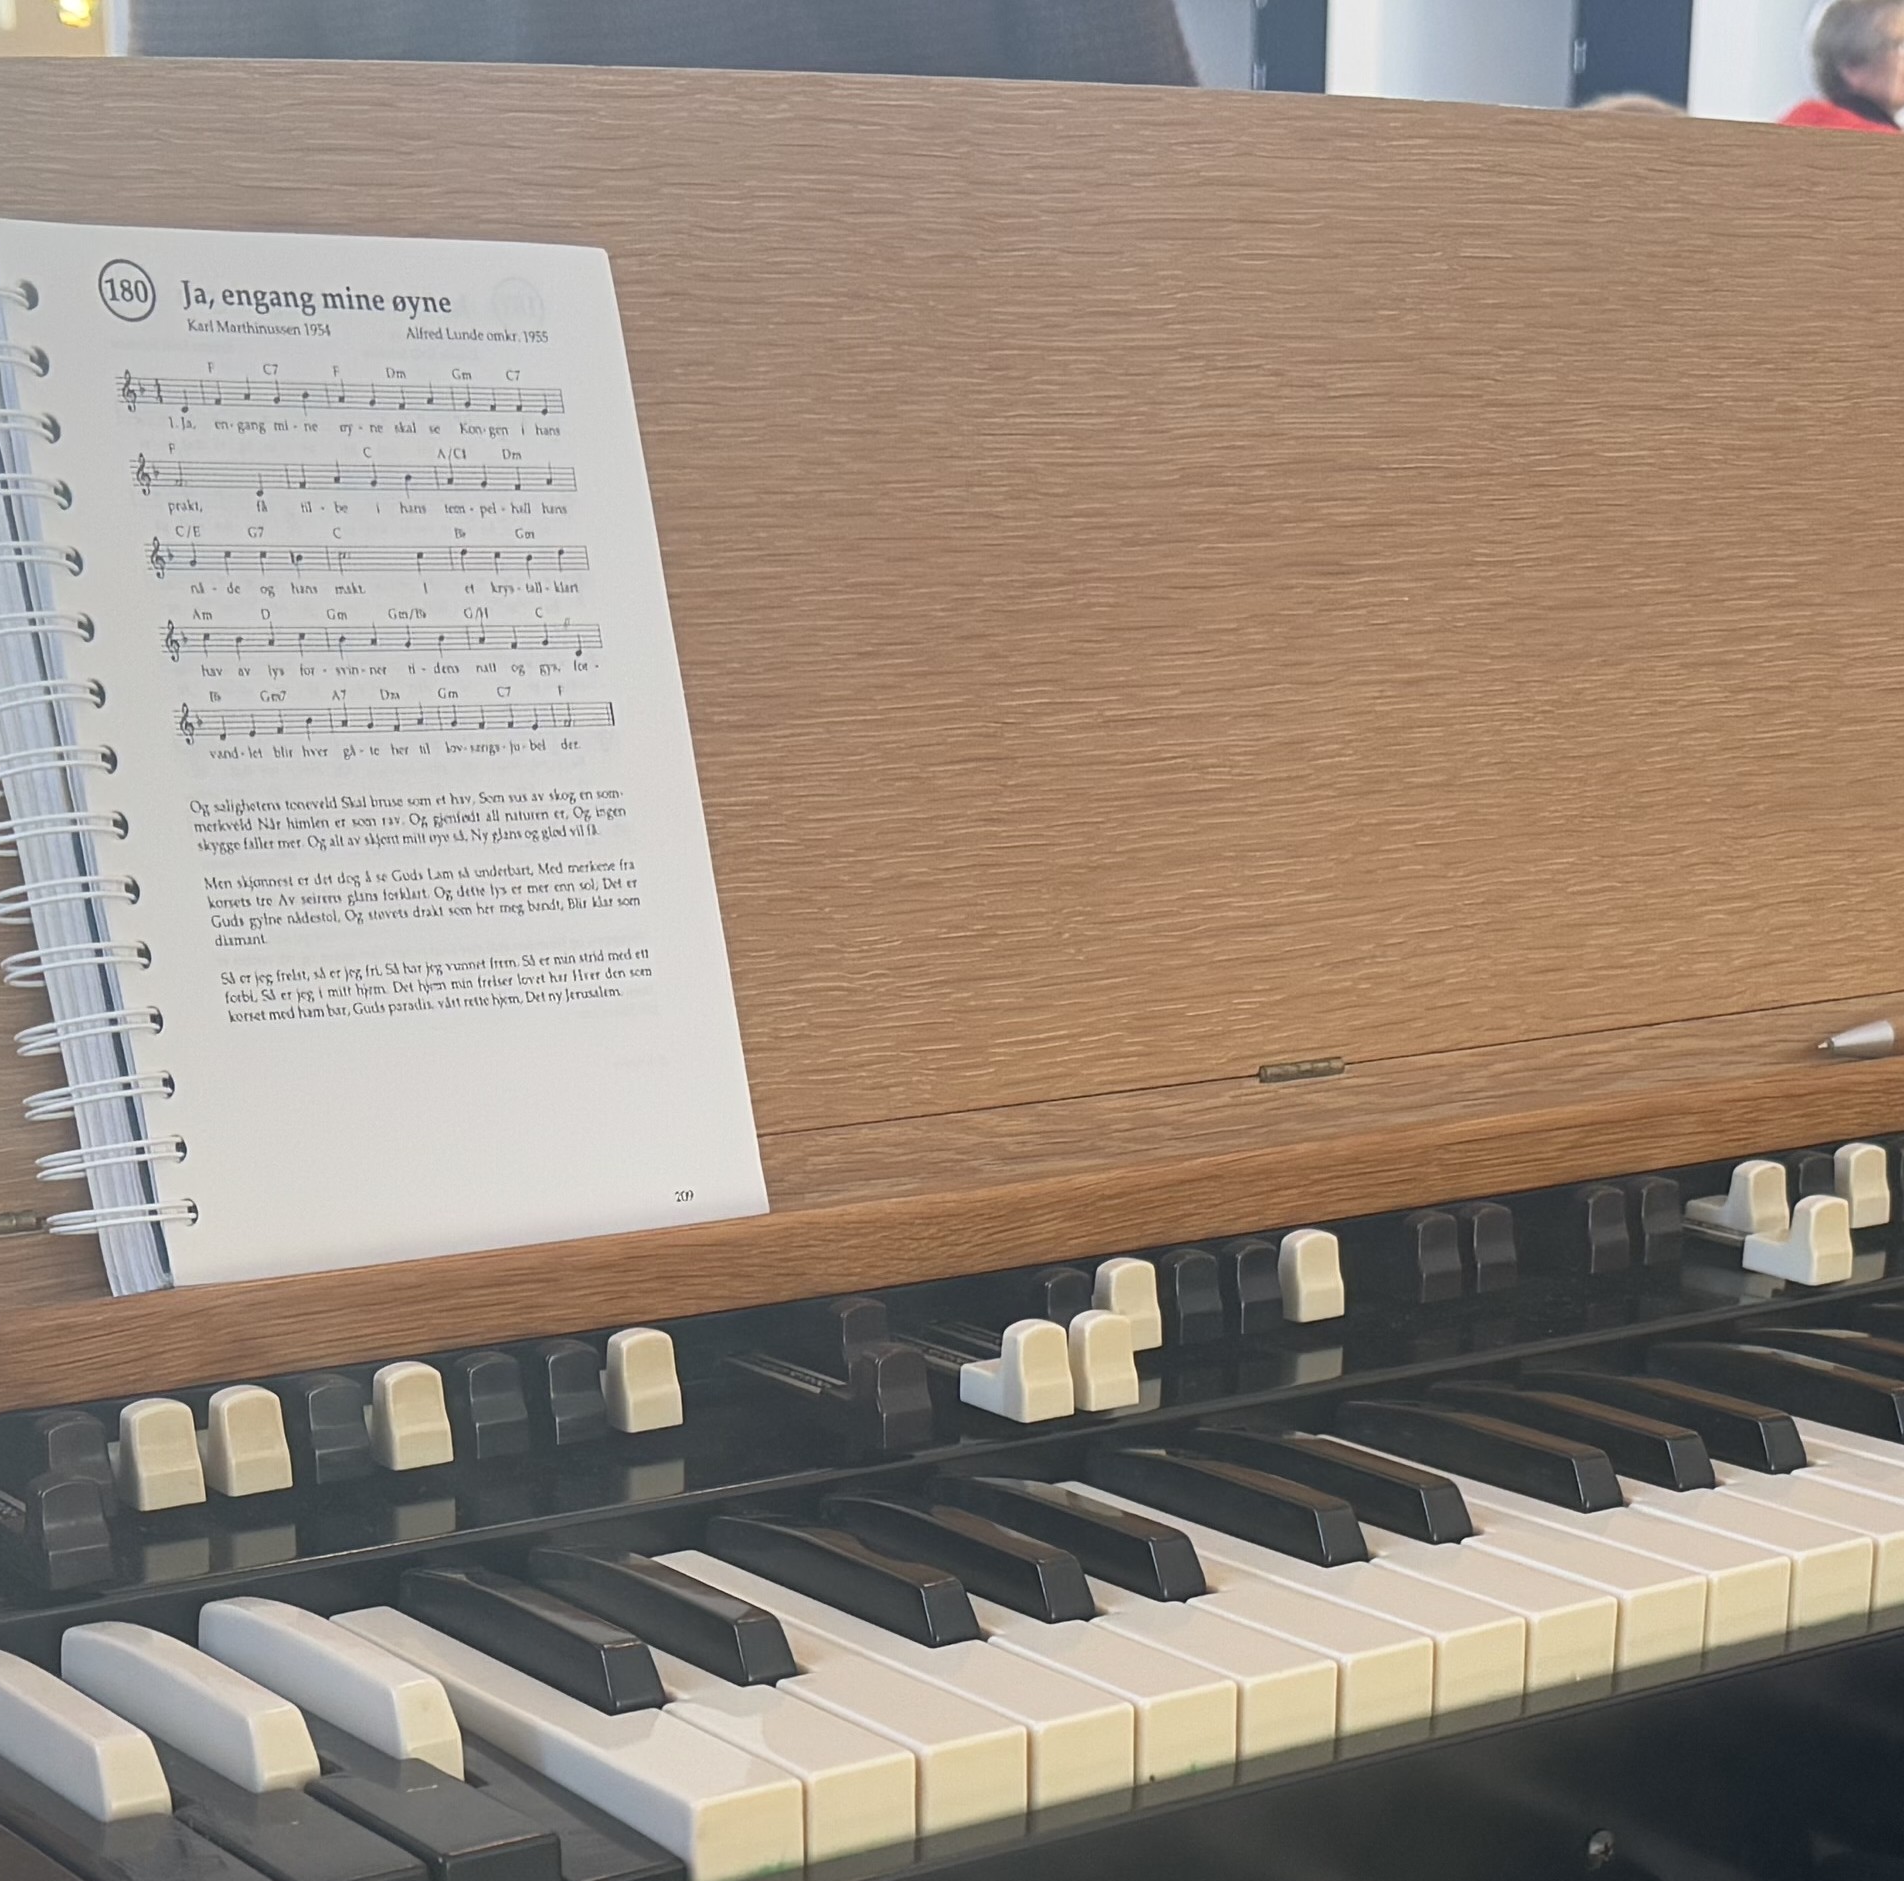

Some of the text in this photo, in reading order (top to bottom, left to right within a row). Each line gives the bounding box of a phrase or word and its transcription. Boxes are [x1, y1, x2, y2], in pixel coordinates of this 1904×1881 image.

[104, 278, 148, 303] 180
[181, 280, 452, 320] Ja, engang mine øyne
[187, 319, 330, 336] Karl Marthinussen 1954
[407, 327, 548, 343] Alfred Lunde omkr. 1955
[263, 364, 278, 375] C7
[386, 367, 406, 378] Dm
[452, 369, 472, 380] Gm
[506, 370, 520, 381] C7
[395, 422, 416, 433] skal
[363, 447, 371, 458] C
[502, 449, 521, 460] Dm
[175, 526, 200, 538] C/E
[248, 526, 264, 538] G7
[333, 527, 341, 539] C
[260, 586, 275, 598] og
[261, 609, 270, 620] D
[327, 609, 347, 620] Gm
[535, 607, 542, 618] C
[332, 689, 346, 701] A7
[438, 688, 458, 699] Gm
[497, 686, 511, 697] C7
[190, 800, 210, 817] Og
[286, 816, 329, 831] himlen
[470, 827, 488, 845] Ny
